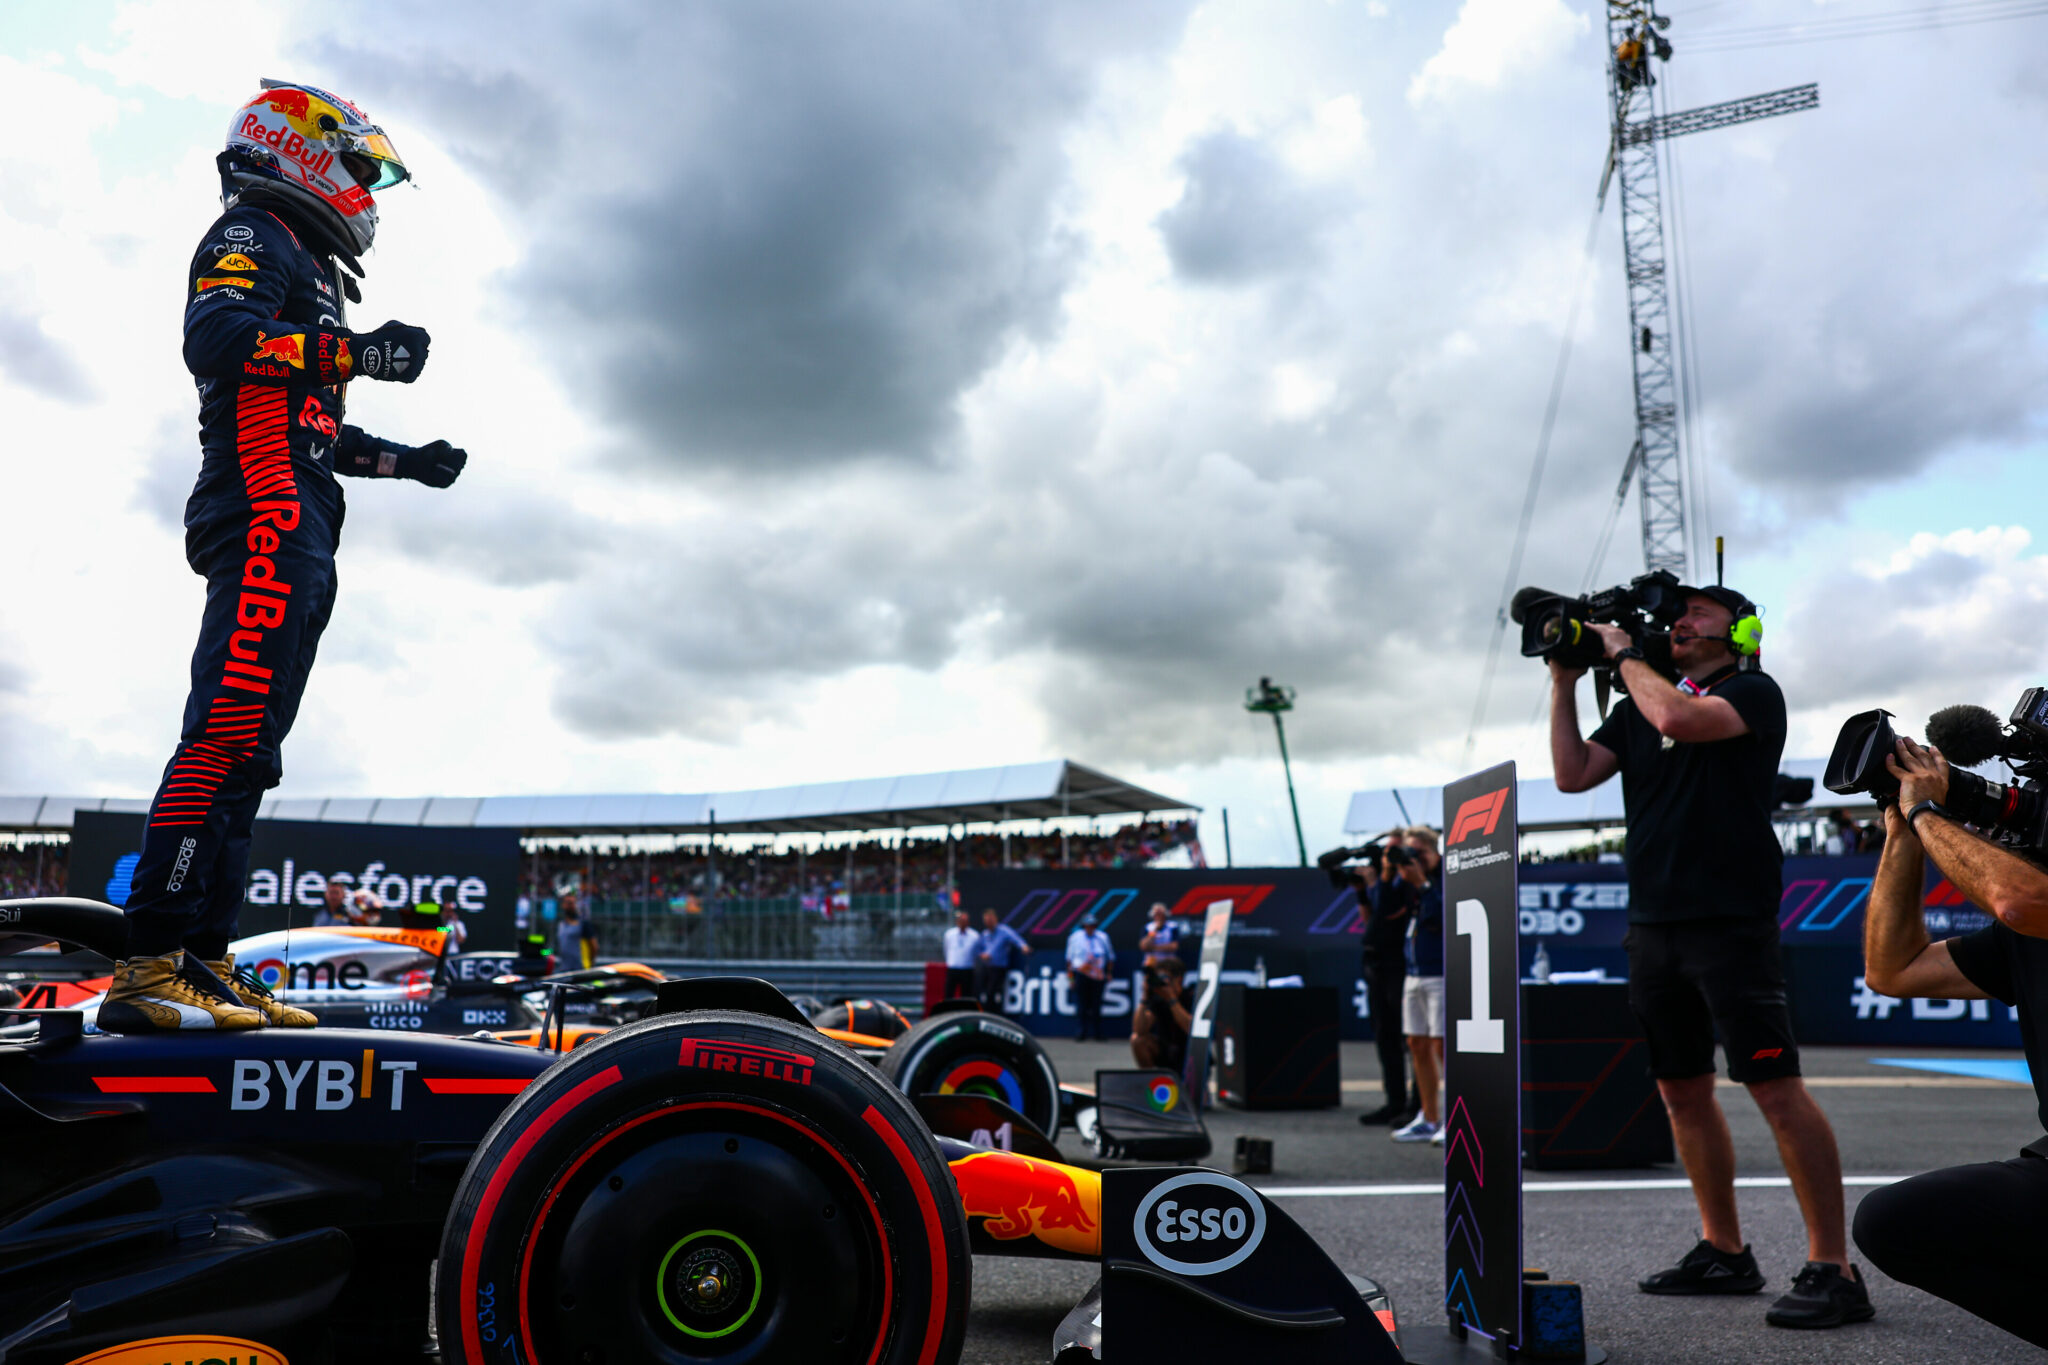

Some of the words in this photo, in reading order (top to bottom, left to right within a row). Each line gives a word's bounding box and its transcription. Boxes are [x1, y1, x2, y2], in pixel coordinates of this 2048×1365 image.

[243, 857, 488, 913] alesforce
[1519, 883, 1564, 909] ET
[1519, 909, 1584, 935] 030
[446, 959, 513, 981] NEOS
[1456, 898, 1504, 1053] 1
[1191, 962, 1219, 1038] 2
[230, 1049, 418, 1111] BYBIT
[678, 1037, 816, 1086] PIRELLI
